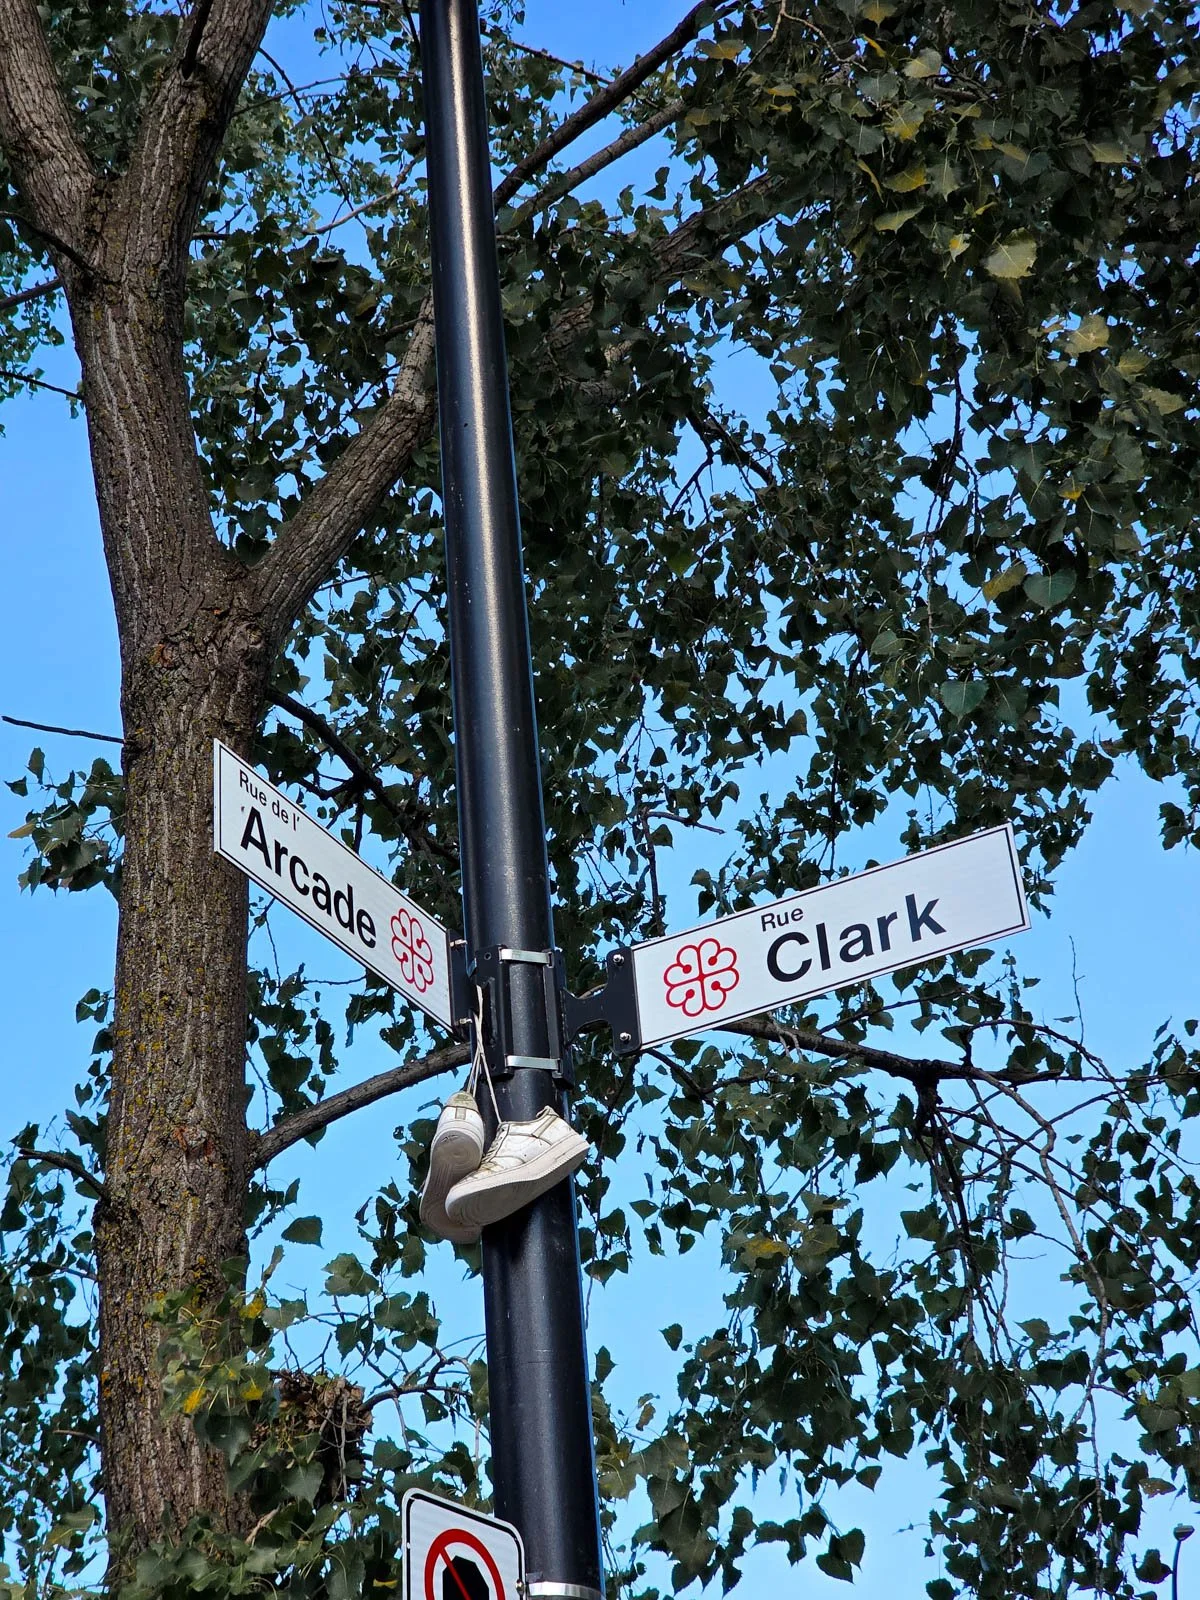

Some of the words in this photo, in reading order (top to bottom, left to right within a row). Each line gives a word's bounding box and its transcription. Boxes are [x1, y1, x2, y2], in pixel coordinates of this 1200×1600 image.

[239, 769, 267, 806] Rue
[271, 799, 289, 824] de
[240, 806, 377, 949] Arcade
[760, 907, 804, 933] Rue
[766, 893, 947, 983] Clark
